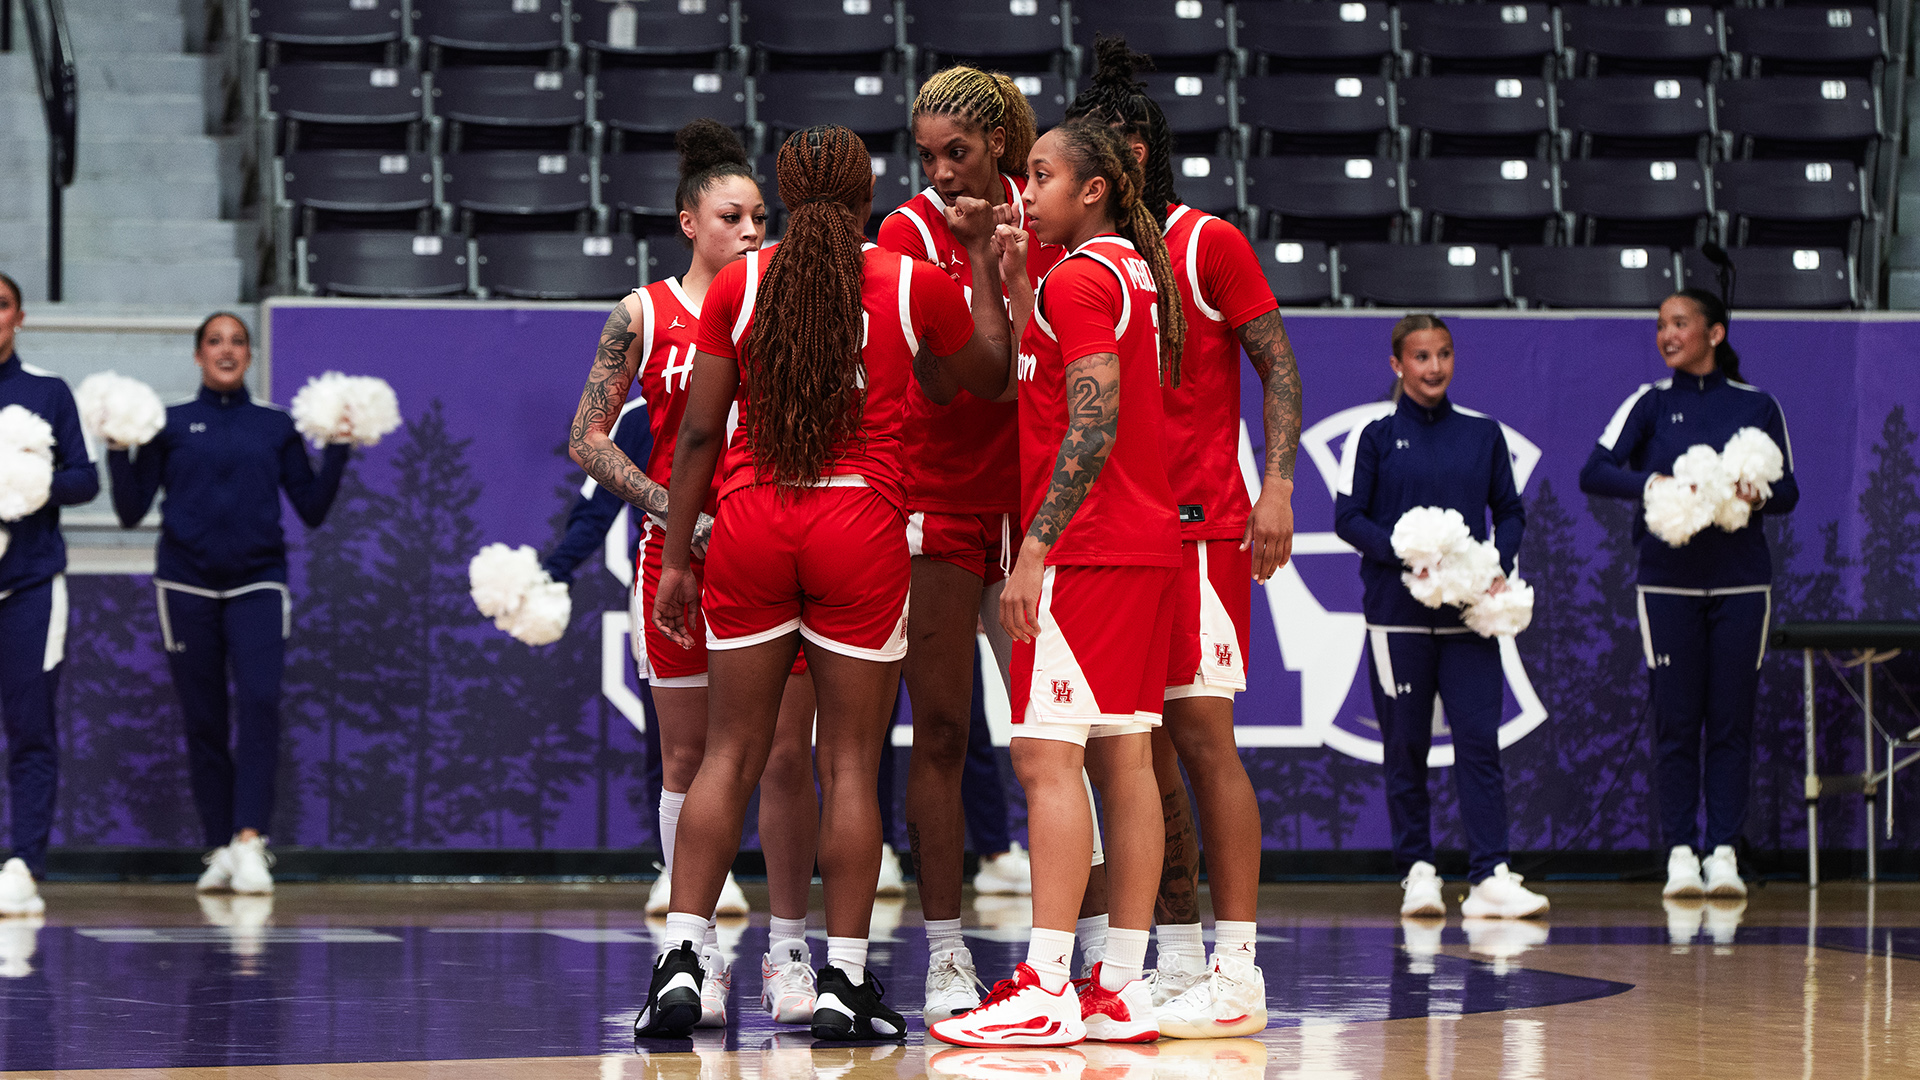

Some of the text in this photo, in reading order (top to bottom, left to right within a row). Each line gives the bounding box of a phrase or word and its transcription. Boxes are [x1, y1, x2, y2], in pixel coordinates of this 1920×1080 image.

[1121, 258, 1158, 294] MERC
[1073, 376, 1103, 418] 2
[1193, 509, 1199, 517] L
[1213, 642, 1233, 667] UH
[1050, 679, 1075, 704] UH
